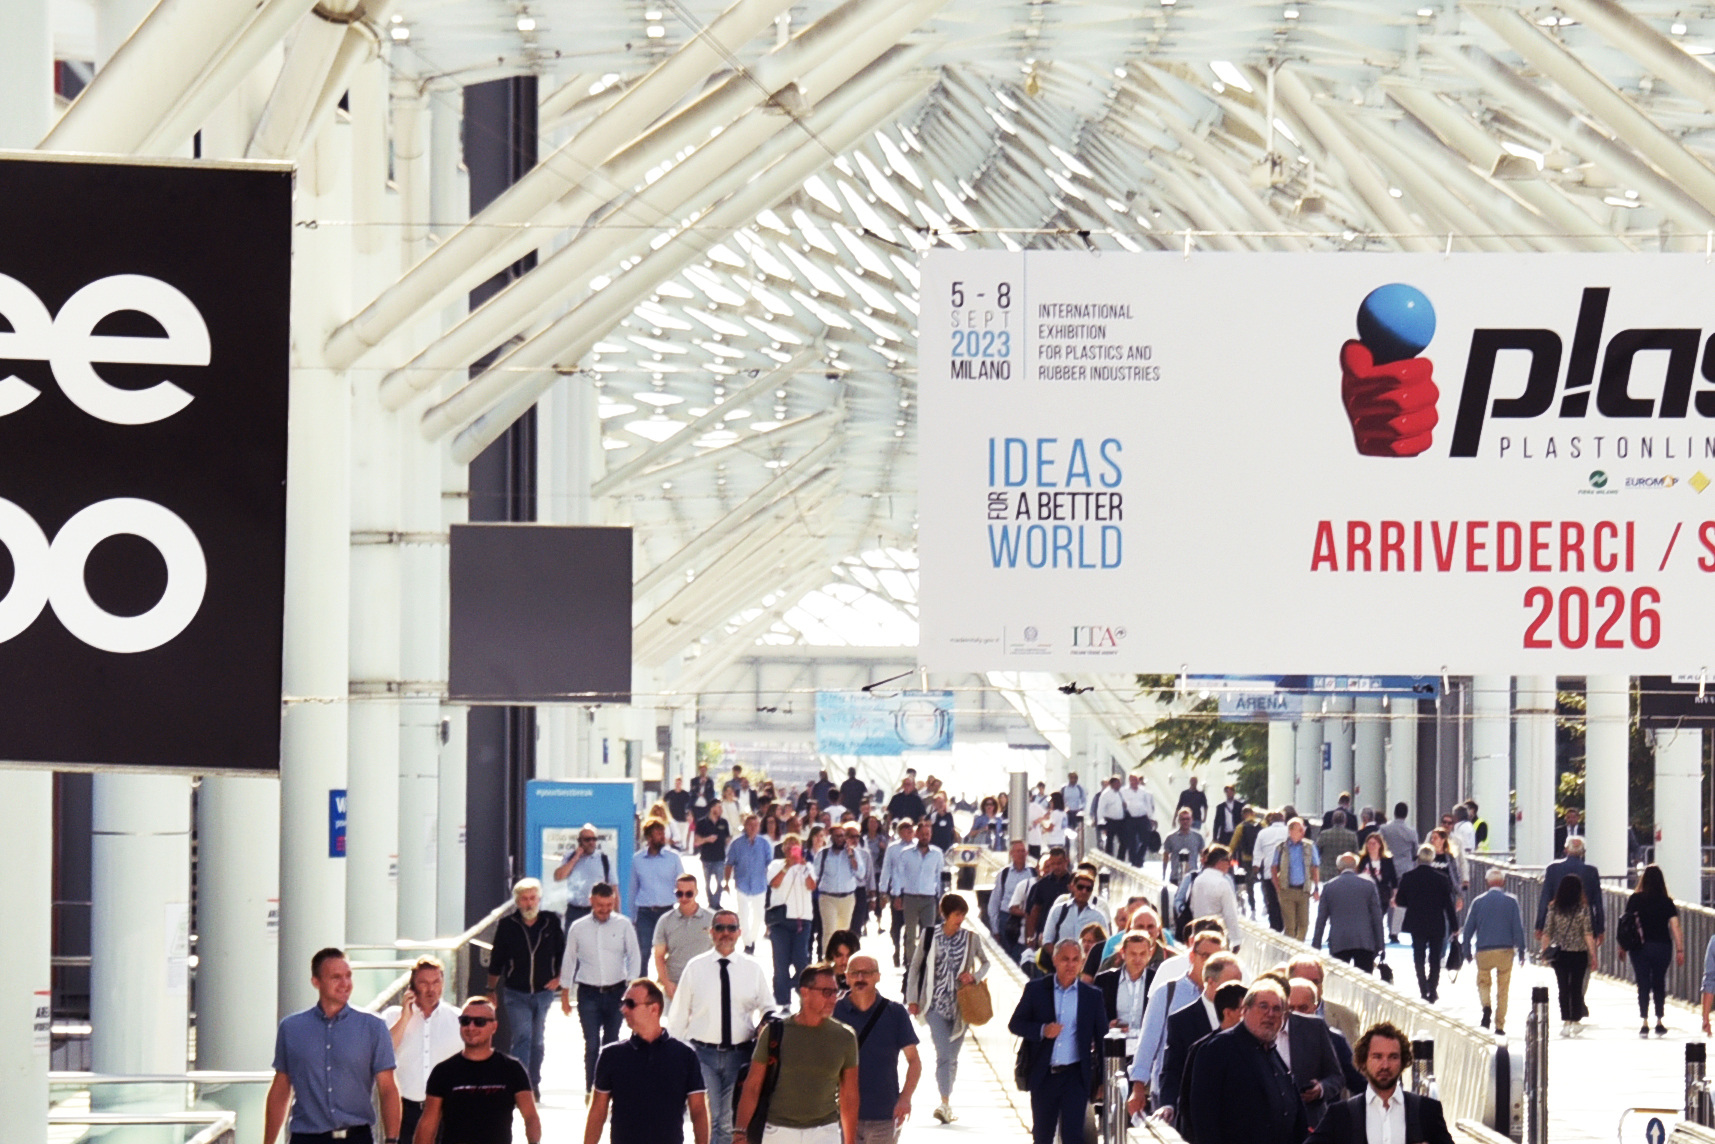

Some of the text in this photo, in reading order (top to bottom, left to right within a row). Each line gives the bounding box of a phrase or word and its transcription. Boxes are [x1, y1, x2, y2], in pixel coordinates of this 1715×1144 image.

[951, 281, 965, 308] 5
[997, 282, 1011, 309] 8
[951, 310, 1011, 328] SEPT
[1038, 303, 1134, 320] INTERNATIONAL
[951, 330, 1011, 358] 2023
[1038, 324, 1107, 340] EXHIBITION
[1038, 345, 1153, 360] FOR PLASTICS AND
[951, 360, 1011, 380] MILANO
[1038, 365, 1161, 382] RUBBER INDUSTRIES
[989, 438, 1123, 489] IDEAS
[1625, 475, 1679, 487] EUROMAP
[988, 491, 1009, 520] FOR
[1015, 491, 1123, 521] A BETTER
[988, 524, 1122, 569] WORLD
[1310, 520, 1636, 573] ARRIVEDERCI
[1658, 521, 1683, 572] /
[1523, 586, 1661, 650] 2026
[1071, 625, 1117, 647] ITA
